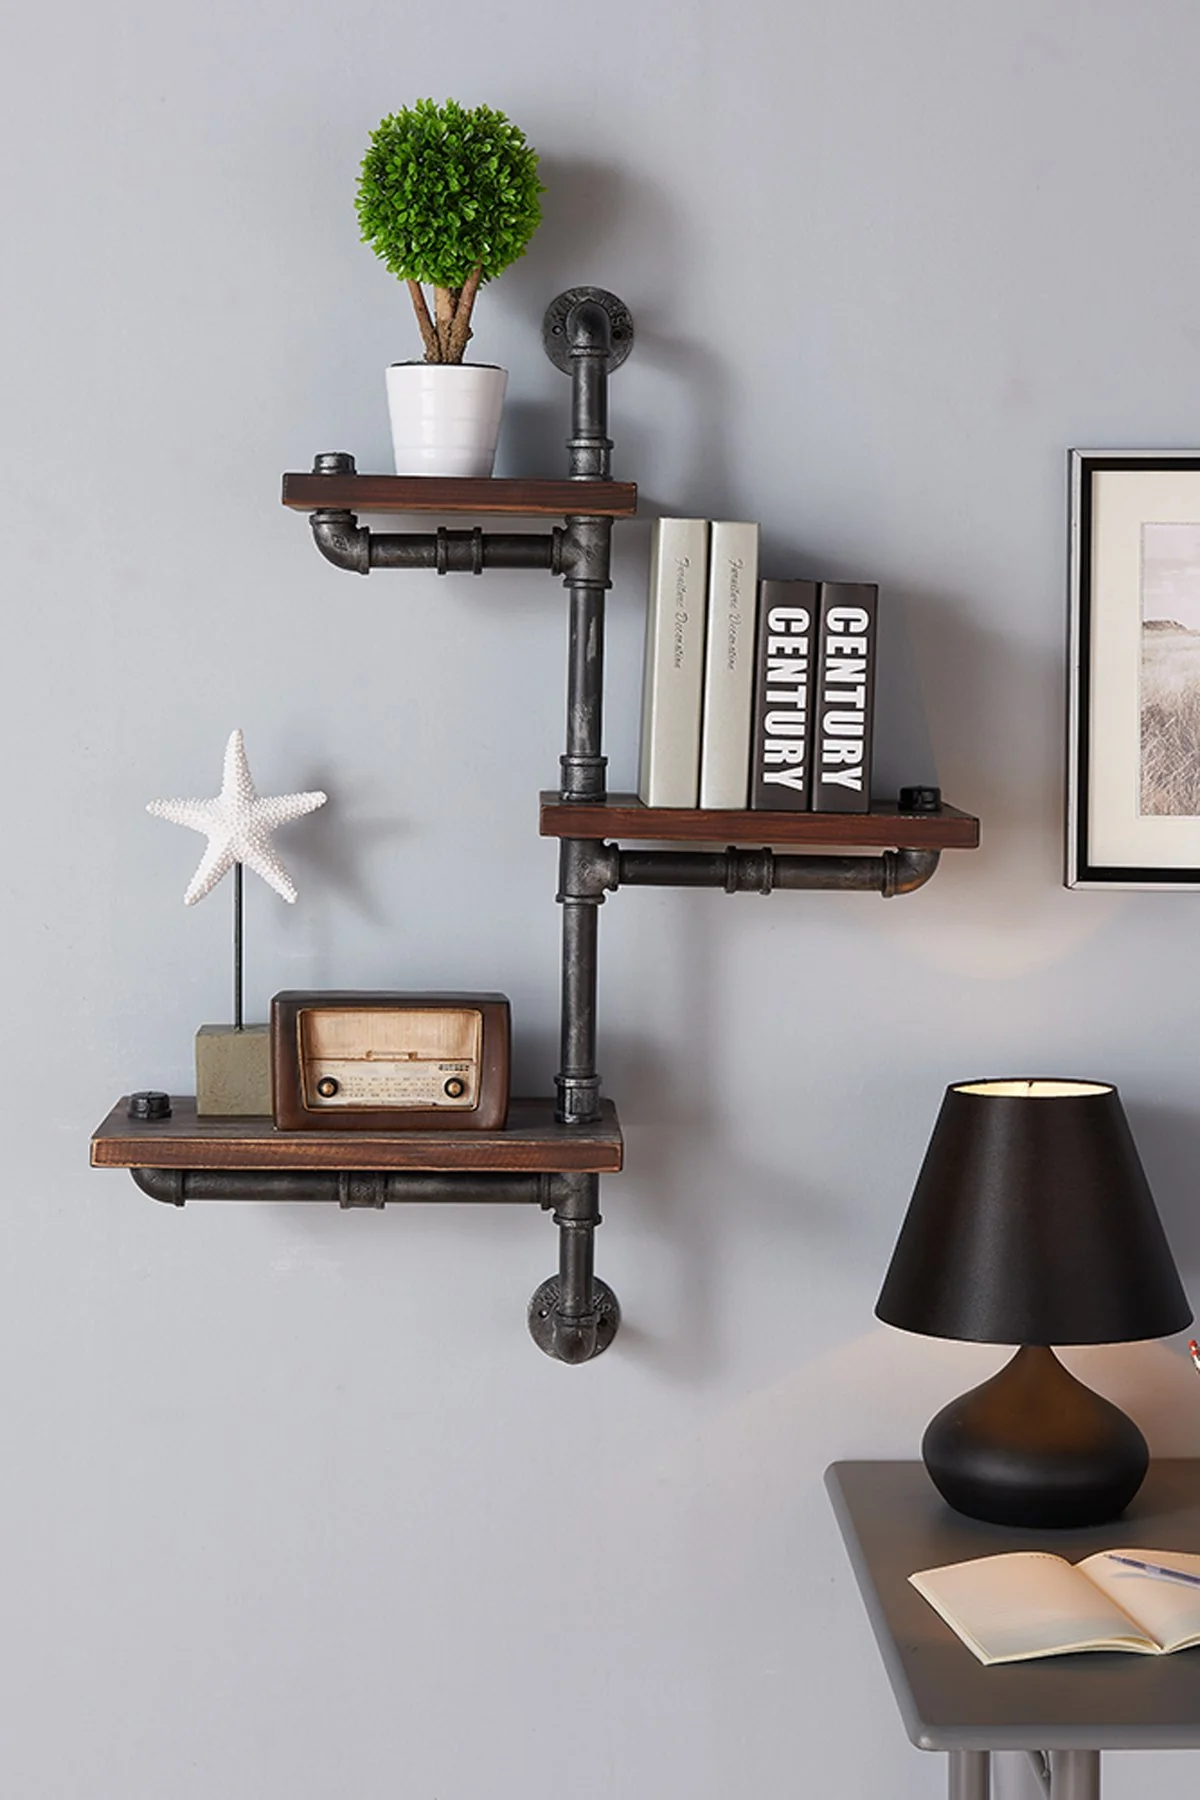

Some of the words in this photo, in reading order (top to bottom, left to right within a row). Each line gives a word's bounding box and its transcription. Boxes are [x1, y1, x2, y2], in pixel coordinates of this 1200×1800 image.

[674, 557, 689, 608] Furniture
[728, 559, 743, 609] Furniture
[674, 612, 688, 669] Decoration
[728, 613, 741, 670] Decoration
[763, 607, 810, 791] CENTURY
[821, 607, 869, 791] CENTURY
